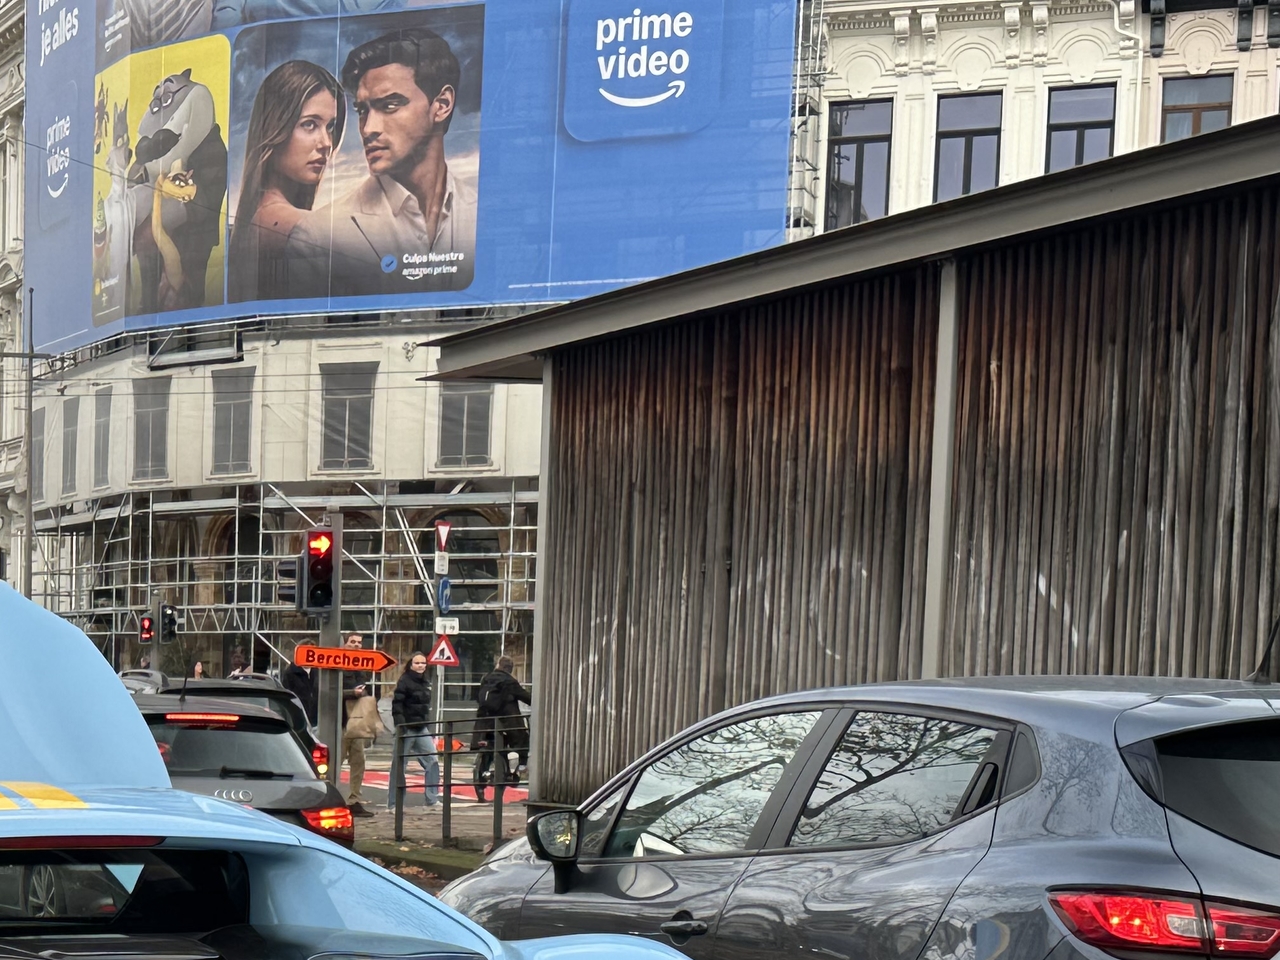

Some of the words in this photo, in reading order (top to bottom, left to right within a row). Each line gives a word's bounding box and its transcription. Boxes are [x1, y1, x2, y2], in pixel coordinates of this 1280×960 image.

[40, 24, 51, 67] je
[52, 7, 79, 50] alles
[596, 8, 693, 51] prime
[597, 45, 690, 80] video
[46, 115, 71, 154] prime
[46, 146, 70, 177] video
[402, 266, 433, 276] amazon
[433, 264, 458, 275] prime
[305, 649, 375, 668] Berchem
